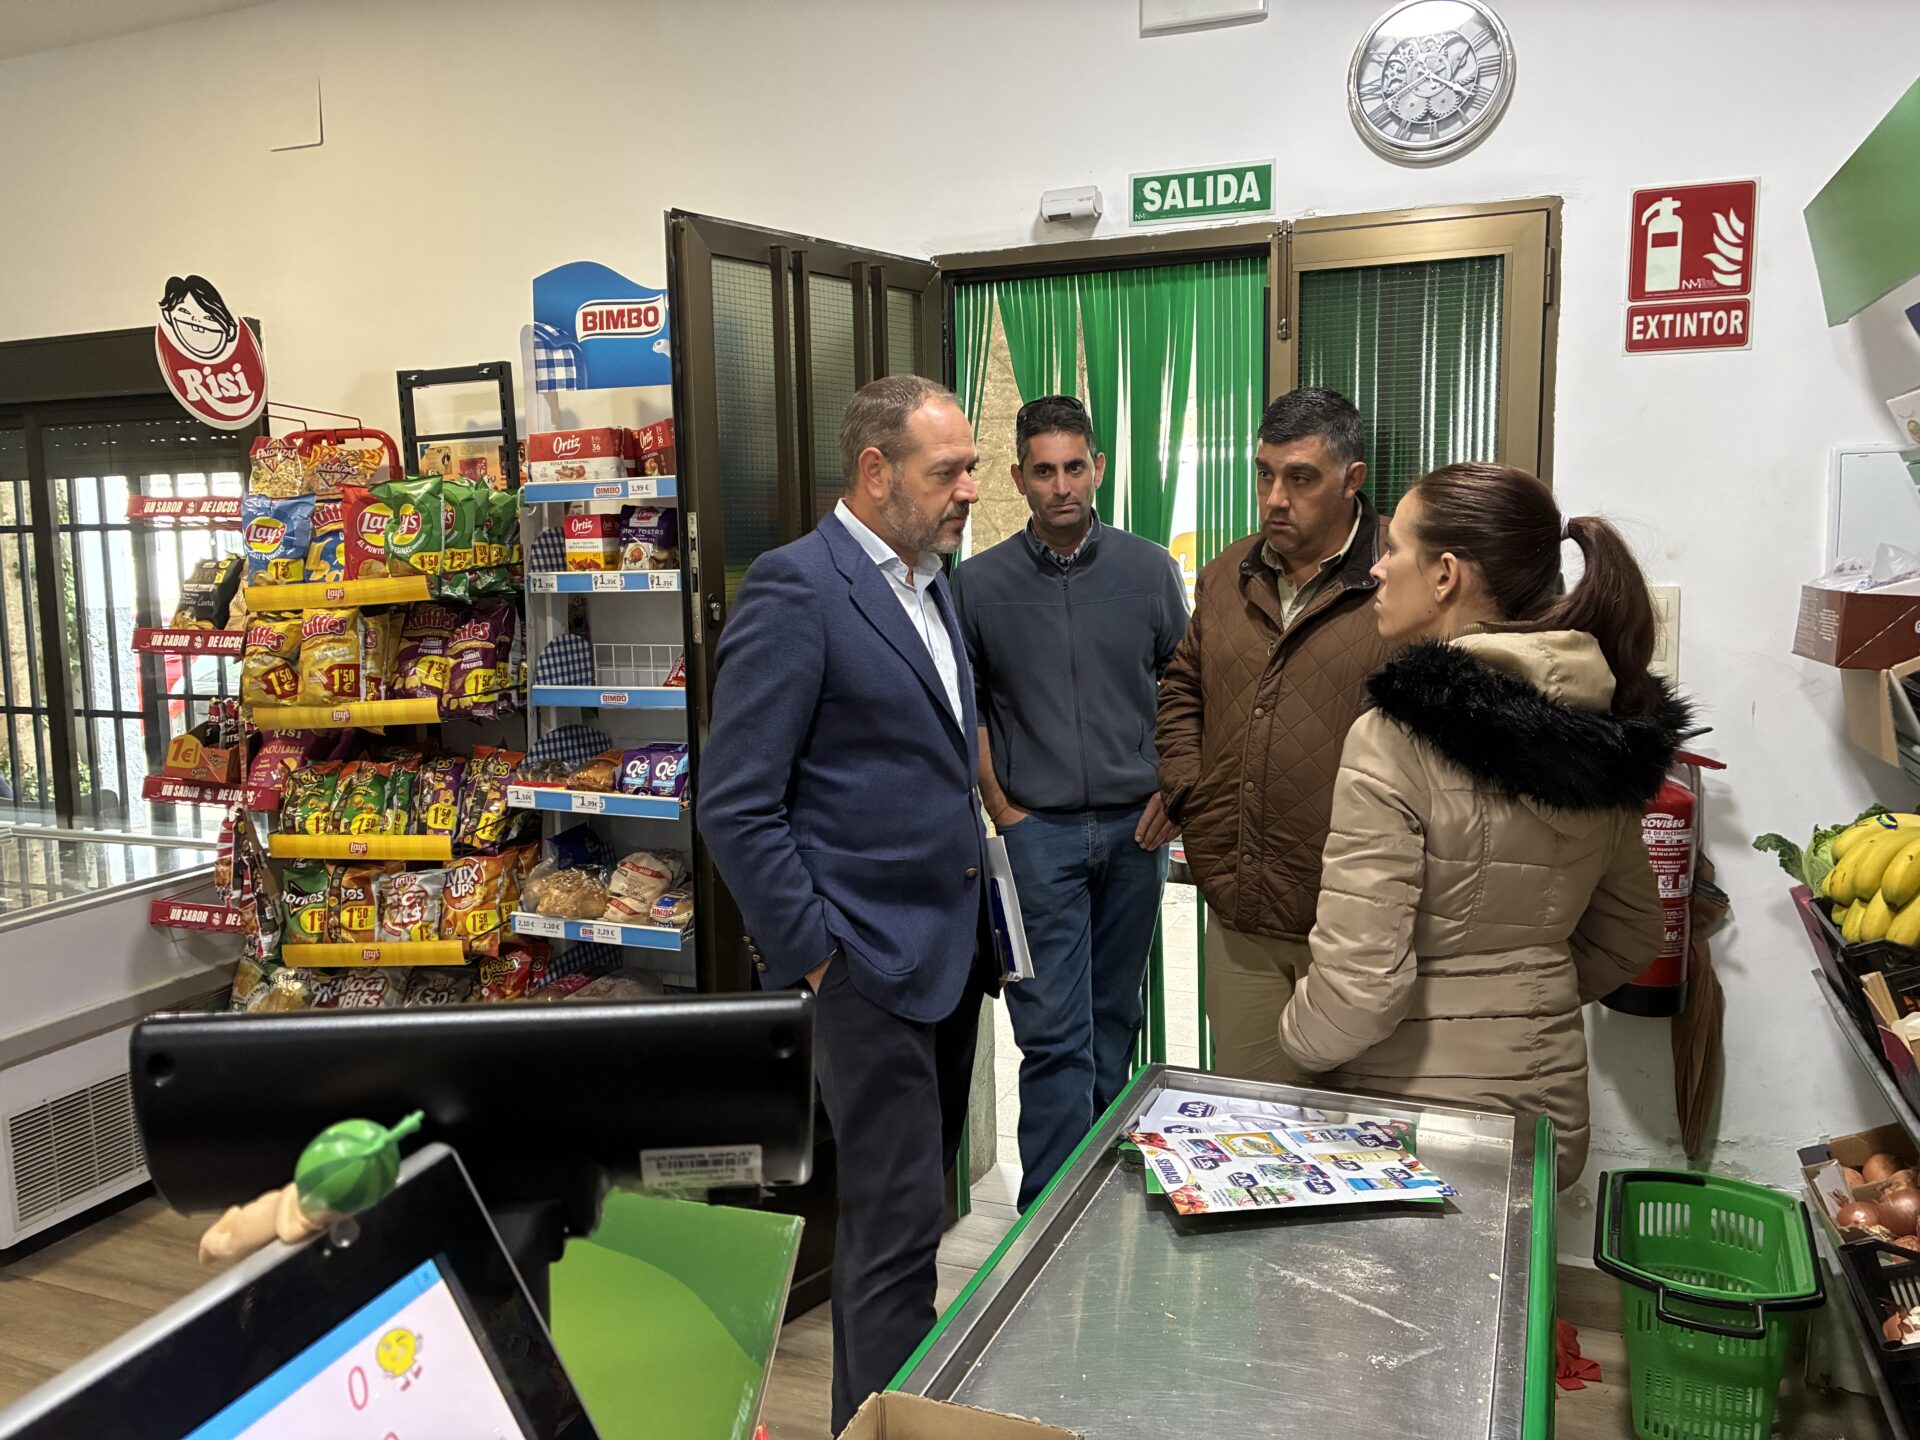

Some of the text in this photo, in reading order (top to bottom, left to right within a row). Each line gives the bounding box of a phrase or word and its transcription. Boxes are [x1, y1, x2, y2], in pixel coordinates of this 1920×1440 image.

[1142, 171, 1261, 212] SALIDA
[582, 305, 659, 332] BIMBO
[1632, 309, 1743, 340] EXTINTOR
[177, 363, 254, 411] Risi
[553, 434, 581, 456] Ortiz
[640, 429, 653, 450] Ortiz
[595, 486, 620, 495] BIMBO
[144, 501, 239, 513] UN SABOR DE LOCOS
[249, 524, 286, 544] Lay's
[571, 519, 594, 535] Ortiz
[356, 540, 385, 555] AL PUNTO
[327, 588, 344, 600] Lay's
[151, 635, 243, 648] UN SABOR DE LOCOS
[269, 668, 293, 696] 1'50
[332, 669, 355, 692] 1'50
[343, 682, 352, 692] €
[333, 710, 350, 722] Lay's
[161, 784, 174, 796] UN
[173, 785, 200, 799] SABOR
[217, 789, 229, 800] DE
[351, 843, 367, 854] Lay's
[396, 876, 416, 888] Lay's
[170, 908, 237, 925] UN SABOR DE
[347, 908, 369, 929] 1'50
[472, 913, 488, 932] 1'50
[363, 949, 380, 960] Lay's
[1154, 1157, 1184, 1185] SEDIACO
